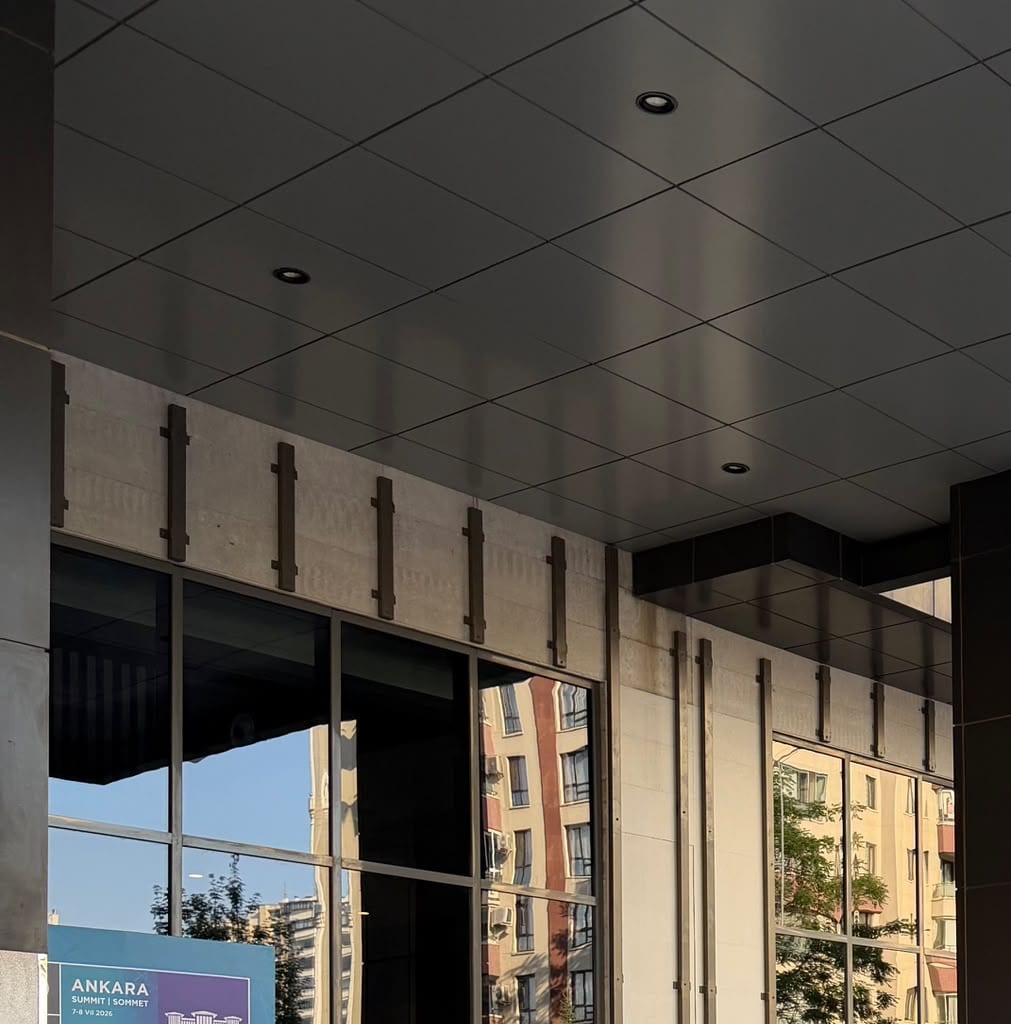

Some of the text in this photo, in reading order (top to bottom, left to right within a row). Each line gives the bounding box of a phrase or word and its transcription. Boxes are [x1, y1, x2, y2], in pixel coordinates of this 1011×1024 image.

[71, 978, 149, 996] ANKARA
[71, 995, 149, 1008] SUMMIT SOMMET
[72, 1008, 83, 1016] 7-8
[95, 1009, 113, 1017] 2026
